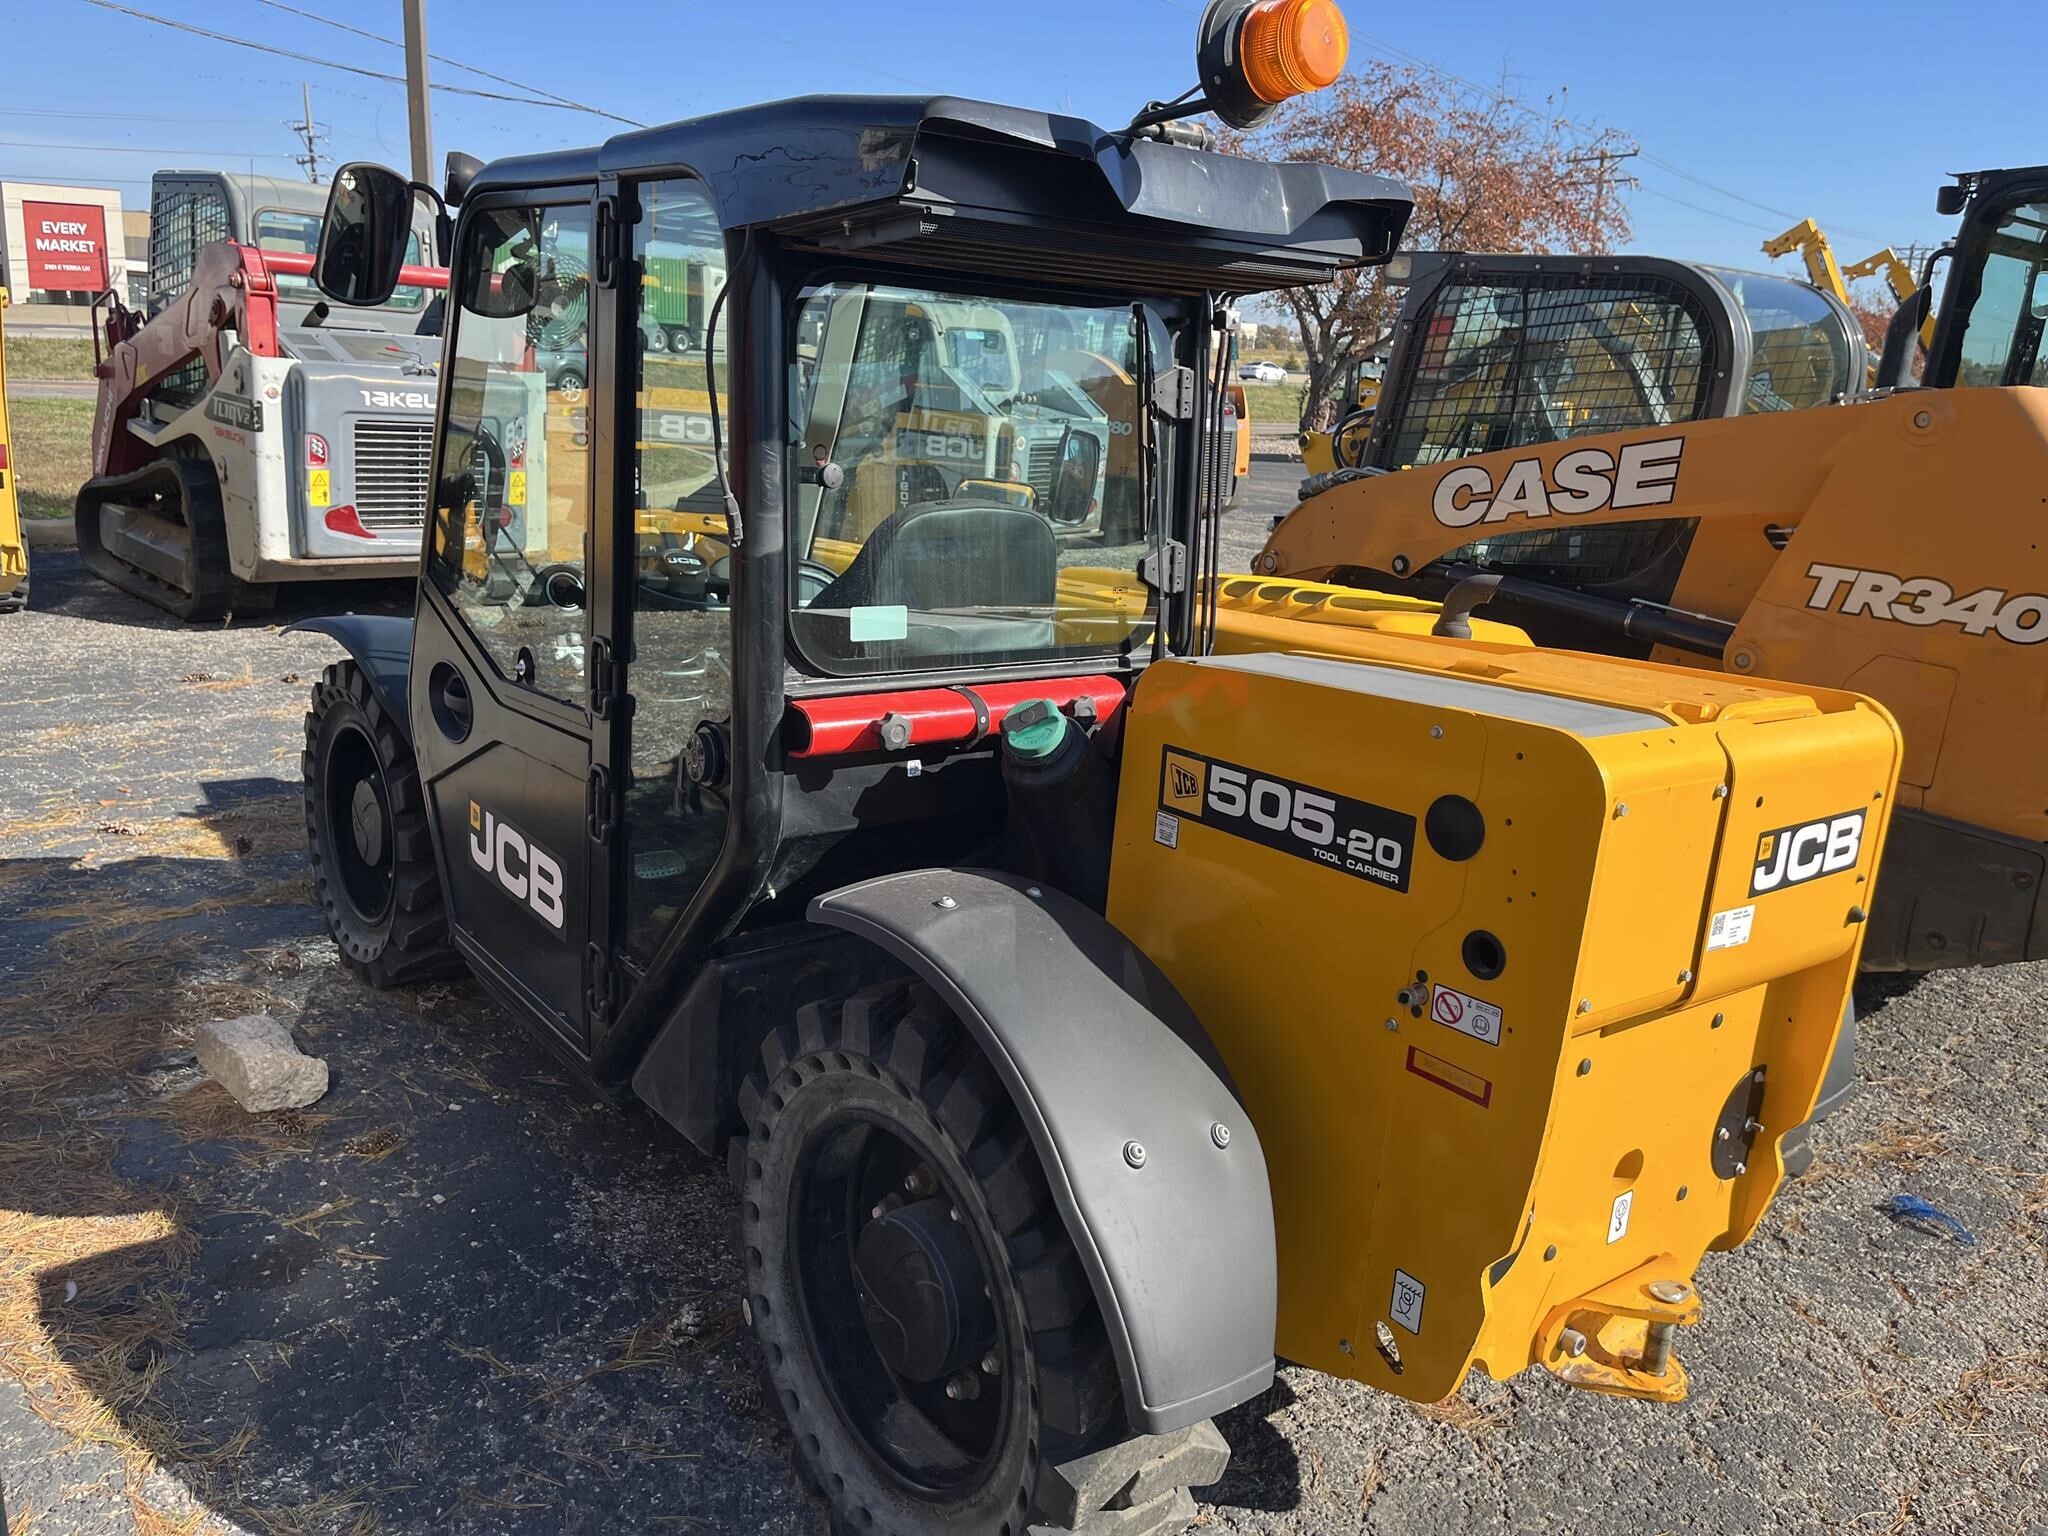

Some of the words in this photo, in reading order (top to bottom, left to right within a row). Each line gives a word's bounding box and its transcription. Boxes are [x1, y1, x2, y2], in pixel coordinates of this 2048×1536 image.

[35, 238, 96, 253] MARKET
[41, 220, 87, 236] EVERY
[1433, 436, 1686, 528] CASE
[668, 557, 702, 566] JCB
[1806, 561, 2048, 645] TR340
[1174, 767, 1199, 797] JCB
[1207, 764, 1402, 870] 505-20
[1753, 814, 1863, 891] JCB
[470, 811, 564, 929] JCB
[1312, 847, 1342, 865] TOOL
[1346, 859, 1399, 885] CARRIER
